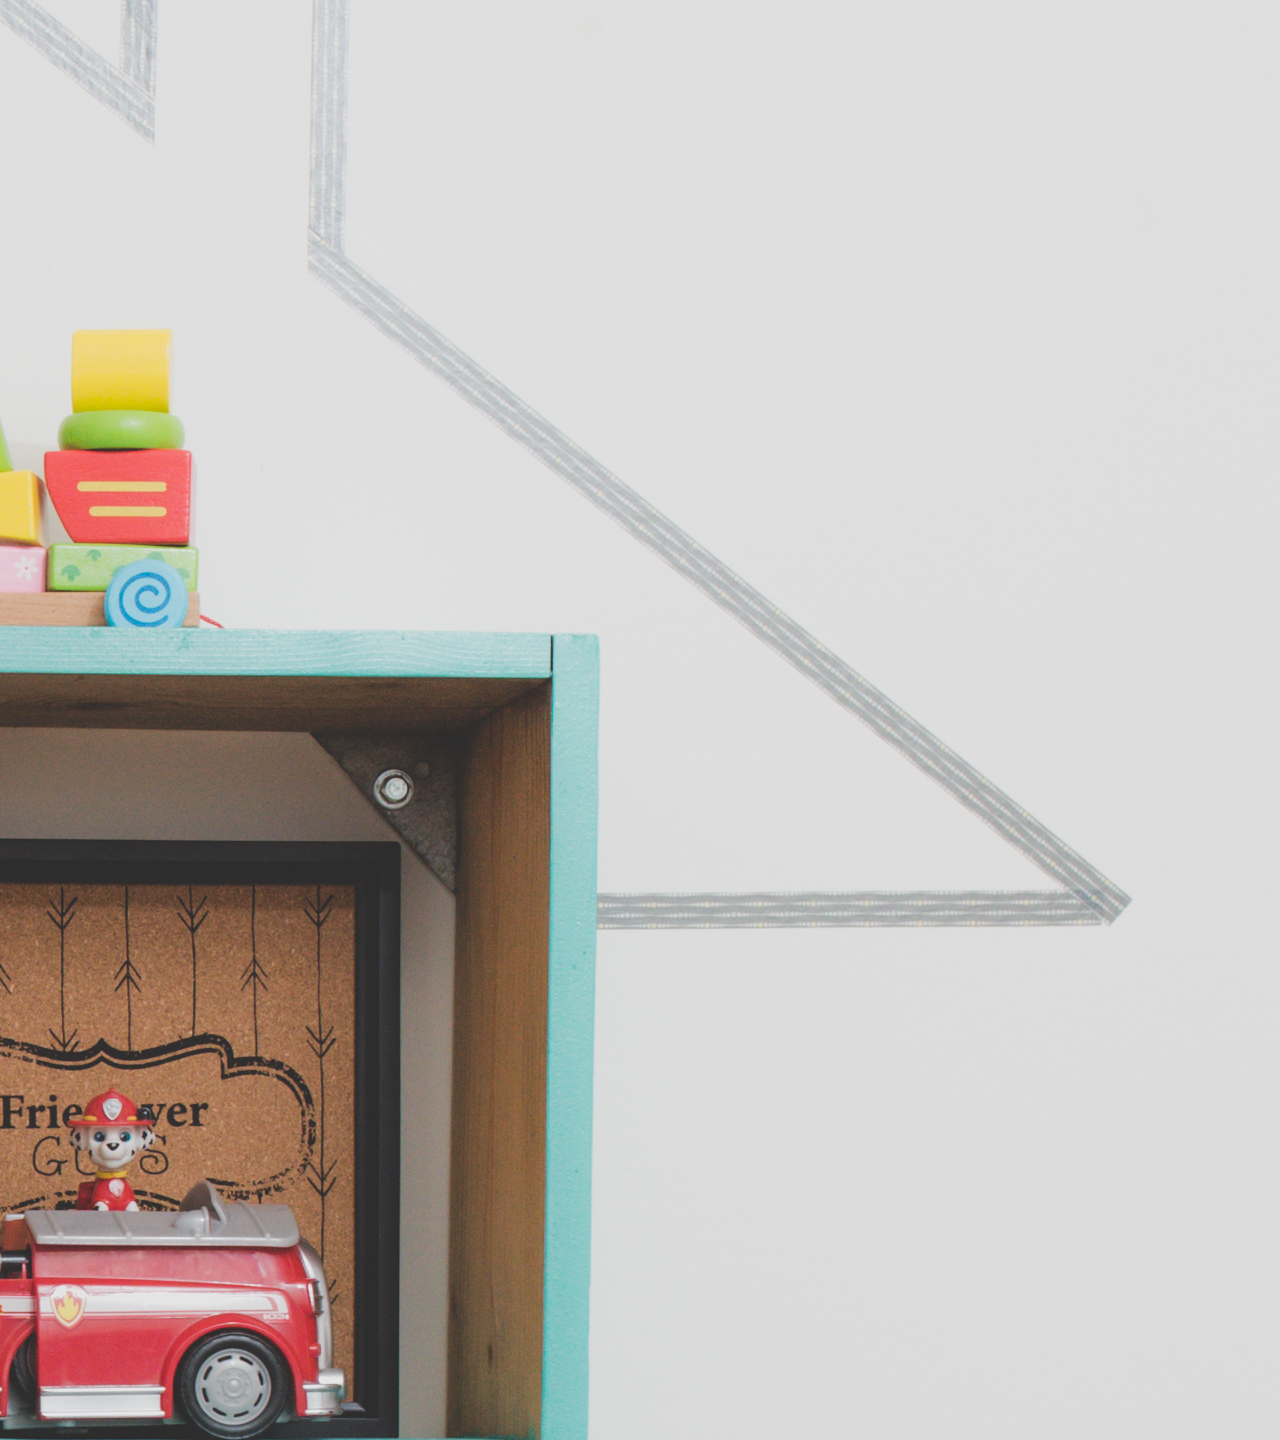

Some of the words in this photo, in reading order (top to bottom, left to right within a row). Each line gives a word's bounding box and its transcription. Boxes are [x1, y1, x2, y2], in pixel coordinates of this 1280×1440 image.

[0, 1094, 83, 1129] Frie
[140, 1101, 209, 1128] ver
[32, 1134, 169, 1177] GS
